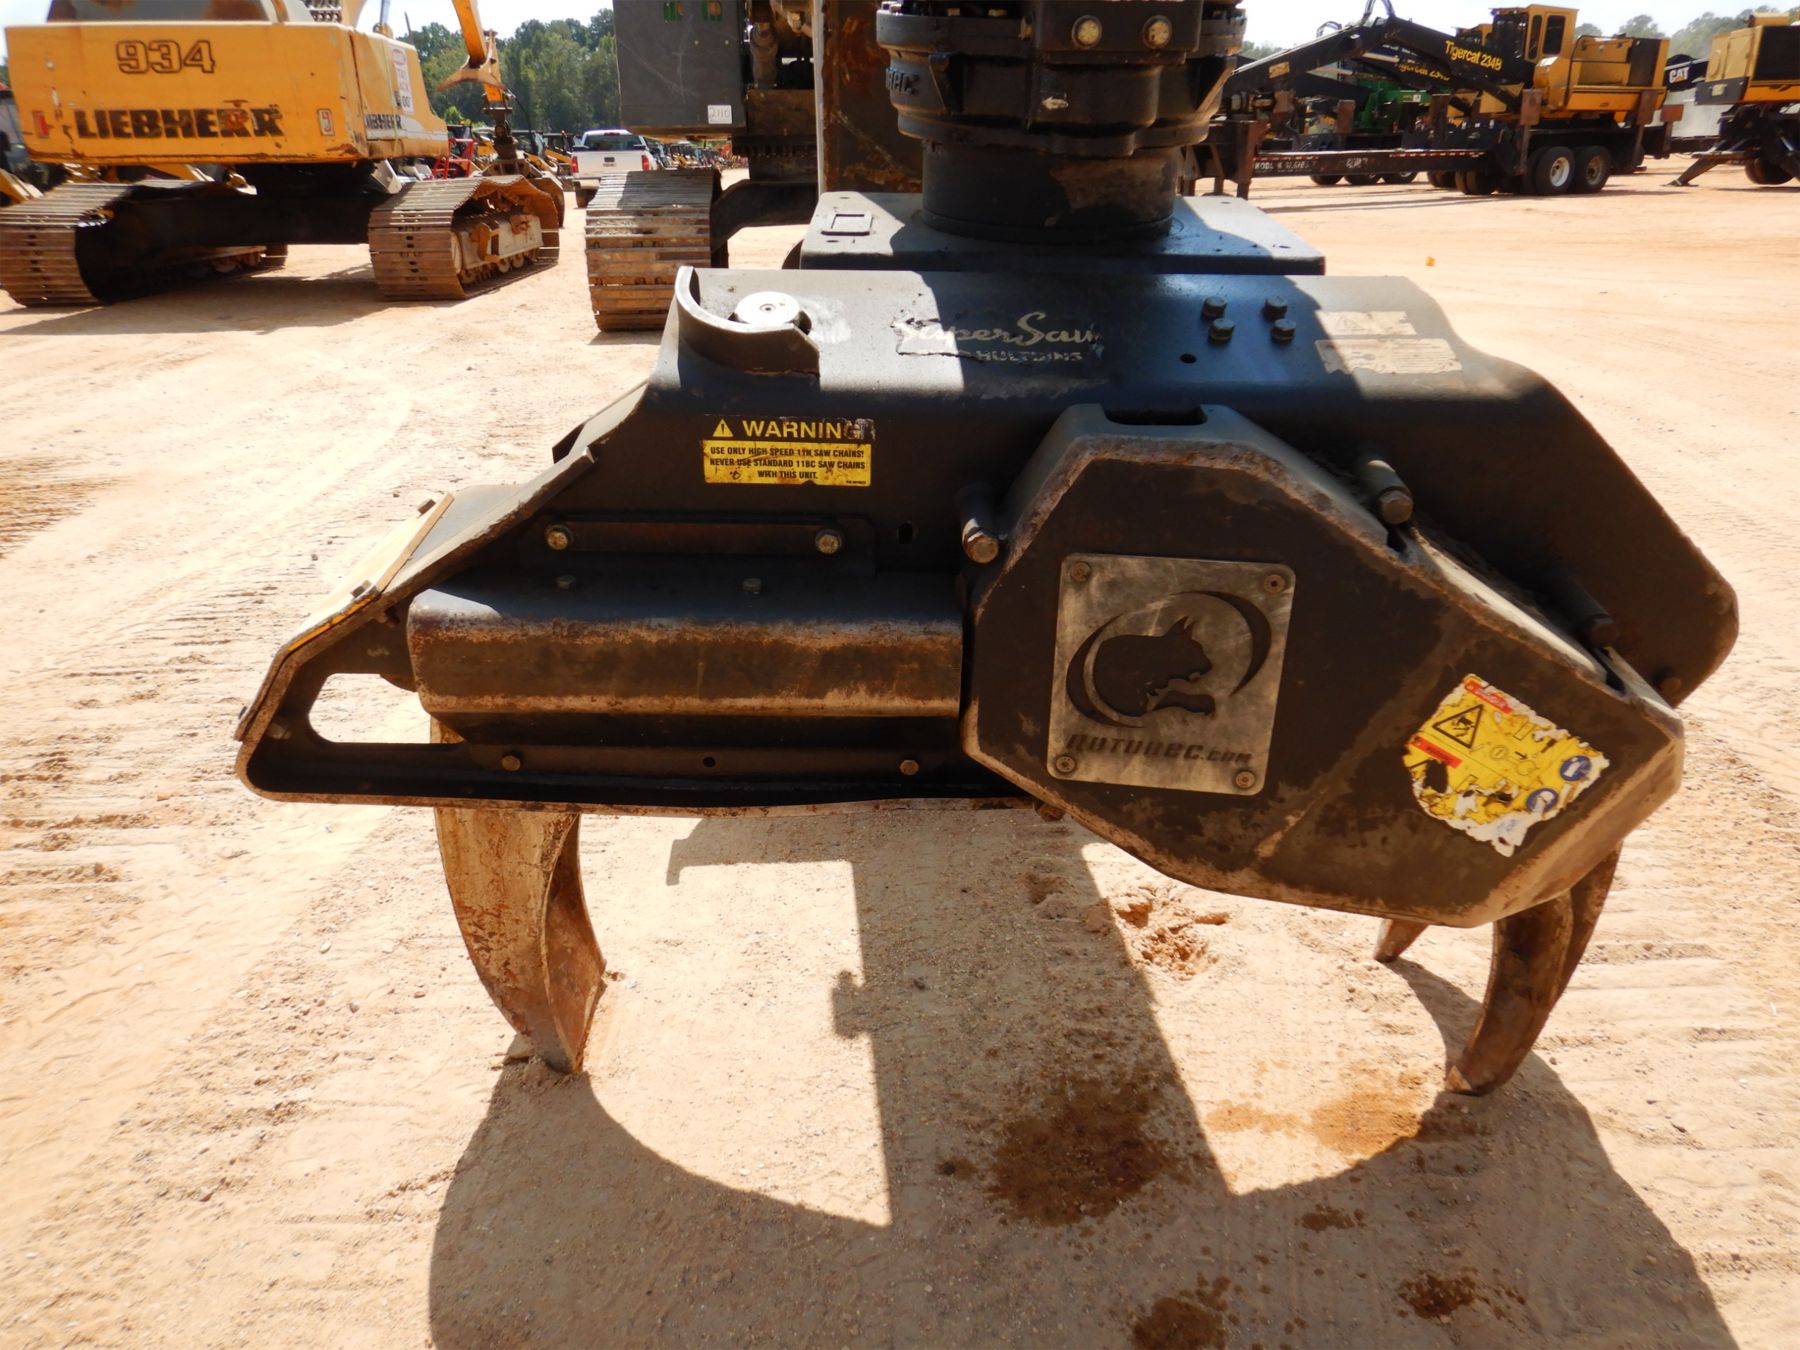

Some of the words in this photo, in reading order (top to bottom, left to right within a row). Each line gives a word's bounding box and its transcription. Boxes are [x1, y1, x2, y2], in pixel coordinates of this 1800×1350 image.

[116, 40, 216, 74] 934
[1445, 40, 1480, 64] Tigercat
[1669, 67, 1690, 84] CAT
[74, 107, 283, 138] LIEBHERR
[710, 447, 725, 455] USE
[727, 447, 746, 455] ONLY
[748, 447, 767, 456] HIGH
[770, 447, 795, 457] SPEED
[814, 449, 831, 457] SAW
[833, 450, 864, 458] CHAINS!
[710, 458, 735, 466] NEVER
[737, 458, 751, 467] USE
[753, 458, 793, 468] STANDARD
[796, 460, 816, 468] 11BC
[818, 460, 835, 469] SAW
[837, 460, 866, 470] CHAINS
[757, 470, 778, 478] WITH
[779, 470, 797, 479] THIS
[799, 471, 818, 480] UNIT.
